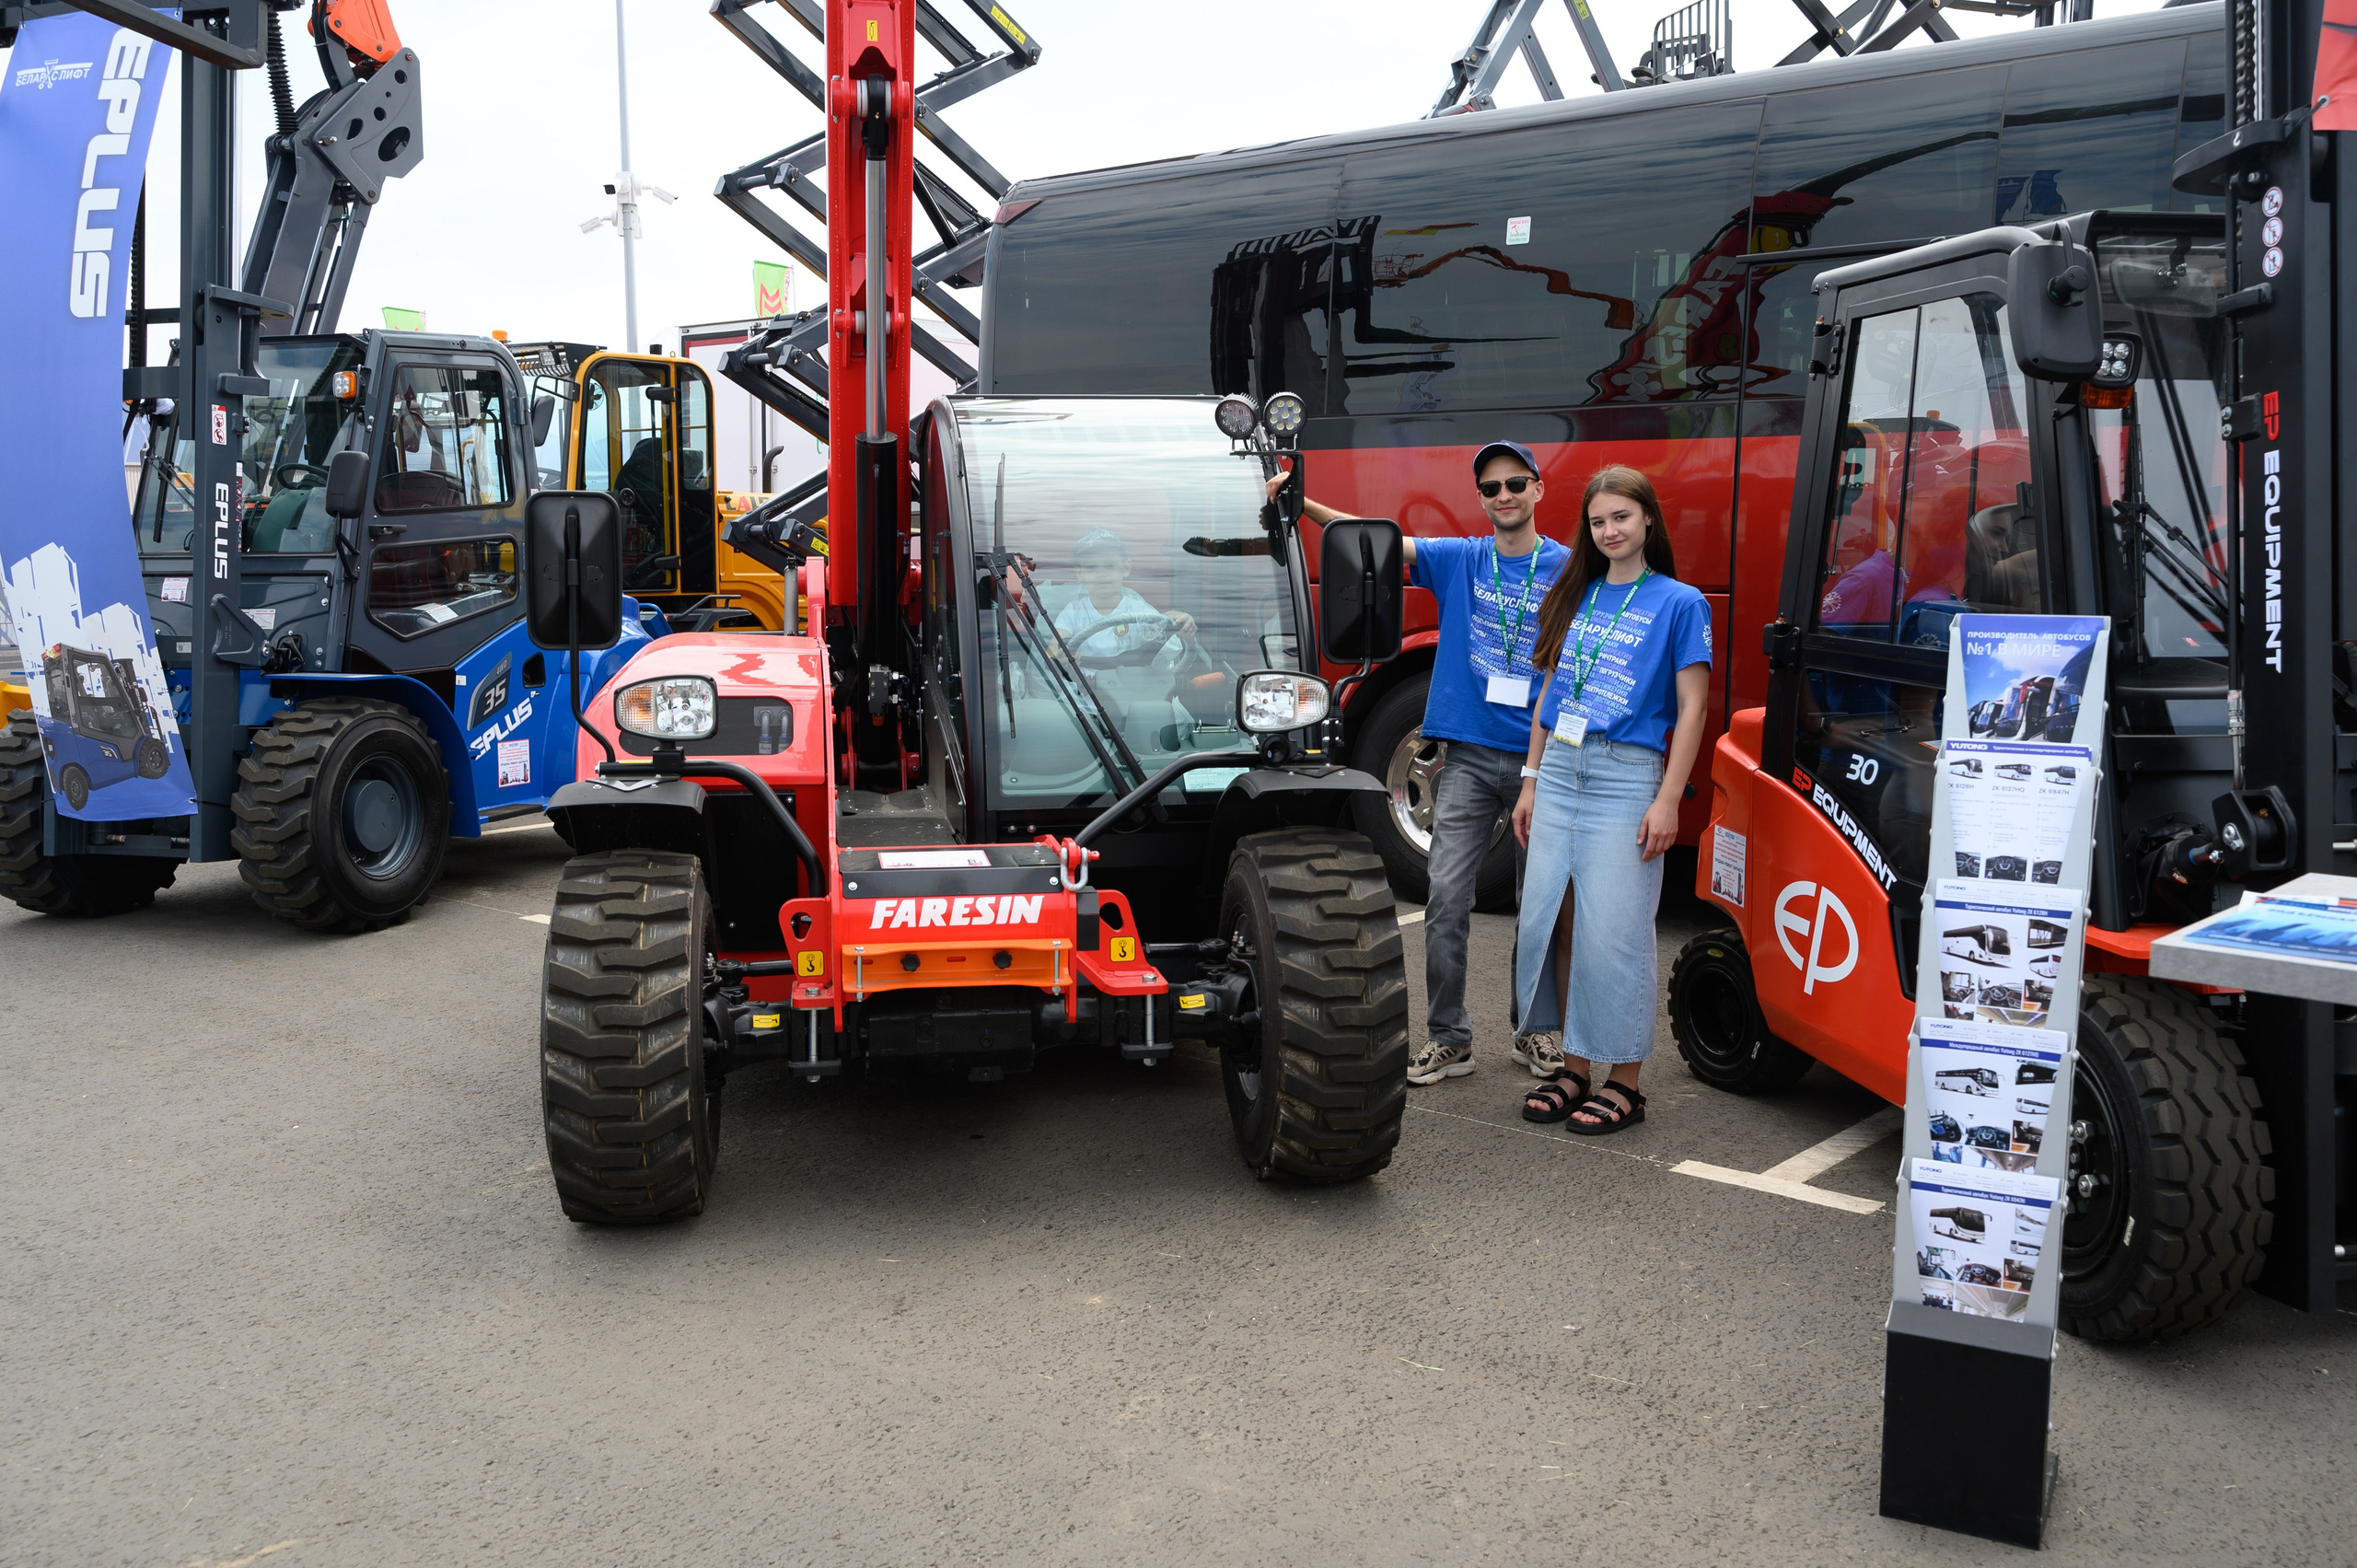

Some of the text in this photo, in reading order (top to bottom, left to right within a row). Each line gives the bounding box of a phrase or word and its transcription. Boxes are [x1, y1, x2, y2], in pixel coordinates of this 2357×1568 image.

[70, 28, 154, 319] EPLUS
[214, 482, 229, 579] EPLUS
[2264, 390, 2282, 674] EP EQUIPMENT
[1621, 611, 1653, 624] АВТОБУСЫ
[1967, 642, 2061, 656] №1 В МИРЕ
[1968, 632, 2038, 640] ПРОИЗВОДИТЕЛЬ
[1598, 668, 1636, 686] ПОГРУЗЧИКИ
[483, 679, 506, 716] 35
[1581, 683, 1629, 704] ЭЛЕКТРОТЕЛЕЖКИ
[1606, 707, 1623, 717] РОСТ
[470, 697, 533, 761] EPLUS
[1950, 742, 1988, 750] YUTONG
[1845, 753, 1879, 785] 30
[1792, 766, 1898, 890] EP EQUIPMENT
[869, 896, 1045, 929] FARESIN
